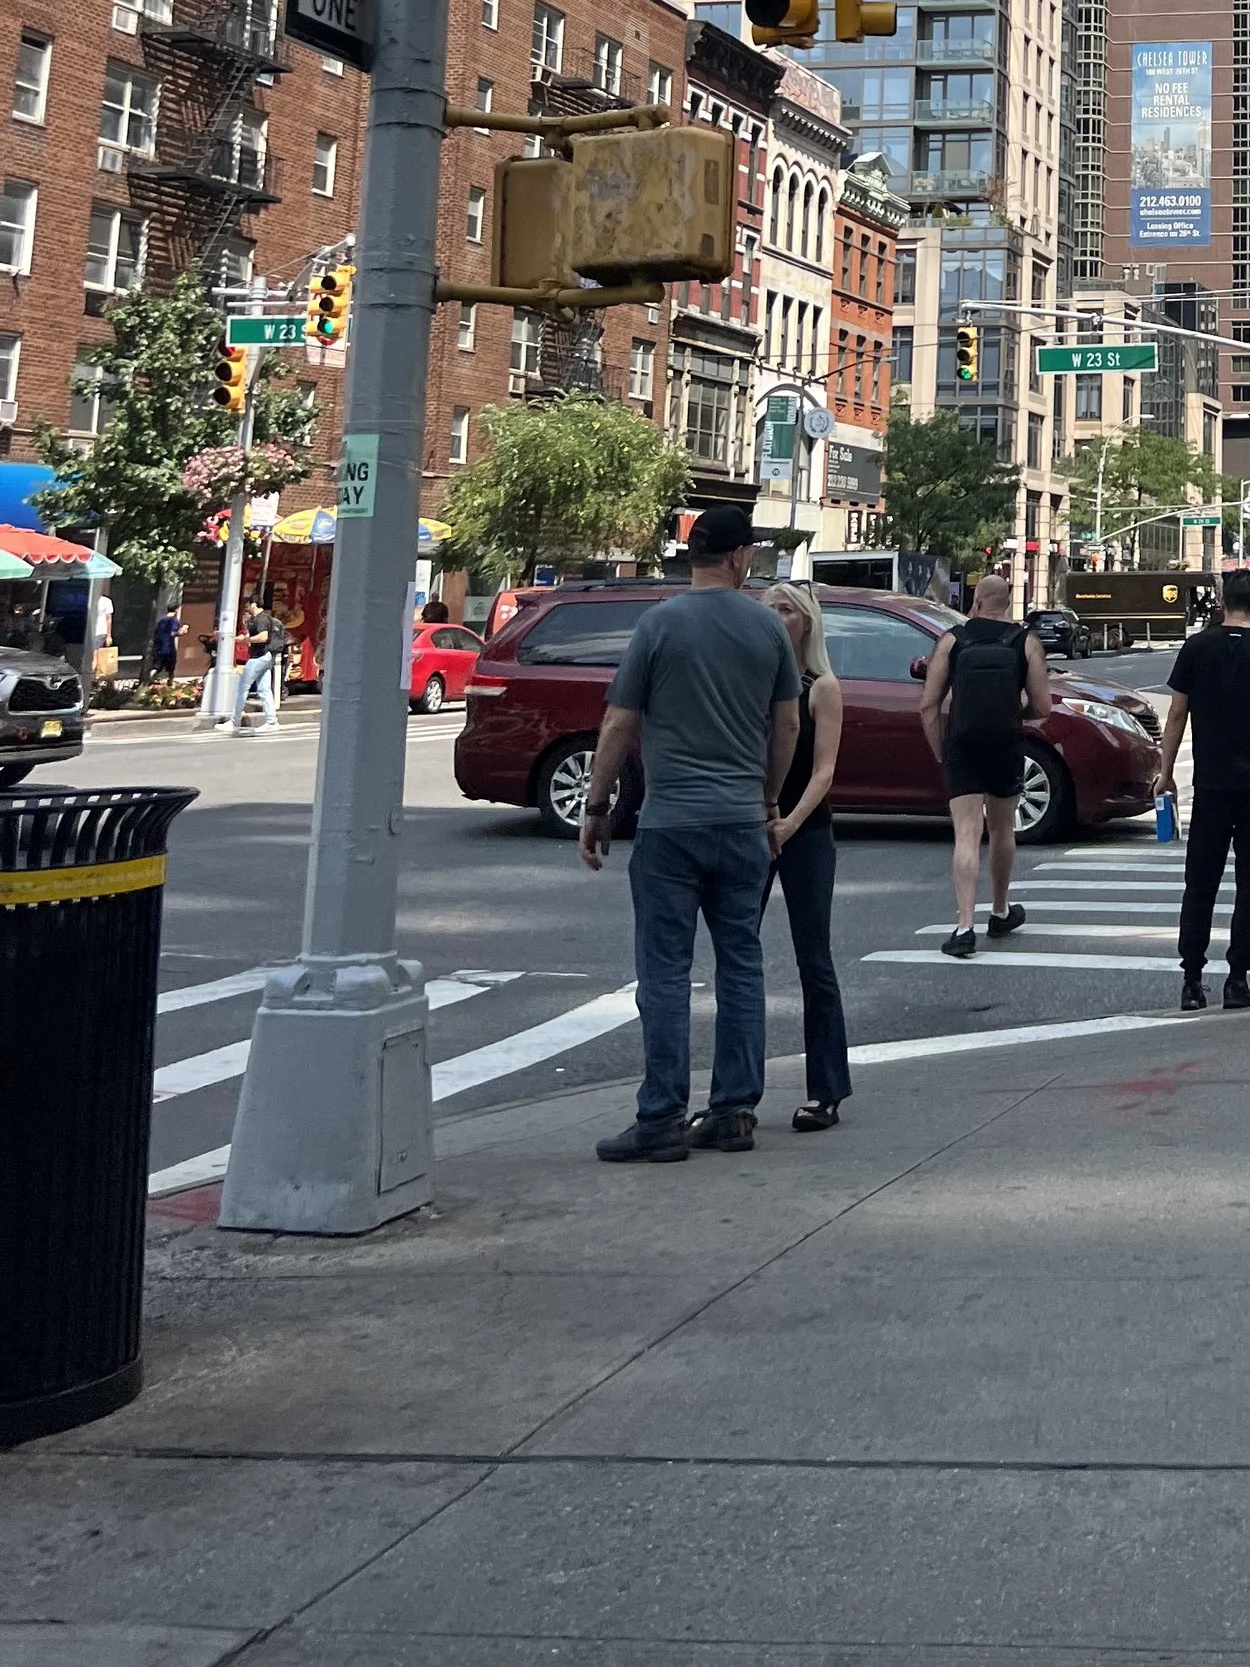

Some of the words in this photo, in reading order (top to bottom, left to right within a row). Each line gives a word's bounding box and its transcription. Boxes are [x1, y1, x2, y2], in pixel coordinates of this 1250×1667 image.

[1137, 51, 1174, 67] CHELSEA
[1178, 50, 1208, 66] TOWER
[1157, 68, 1173, 76] WEST
[1155, 82, 1170, 94] NO
[1172, 82, 1189, 94] FEE
[1153, 94, 1190, 106] RENTAL
[1141, 106, 1202, 118] RESIDENCES
[1139, 195, 1202, 207] 212.463.0100
[264, 324, 275, 340] W
[279, 324, 296, 340] 23
[1071, 352, 1083, 368] W
[1086, 352, 1103, 368] 23
[1107, 351, 1121, 367] St
[345, 462, 369, 482] NG
[340, 486, 365, 505] AY
